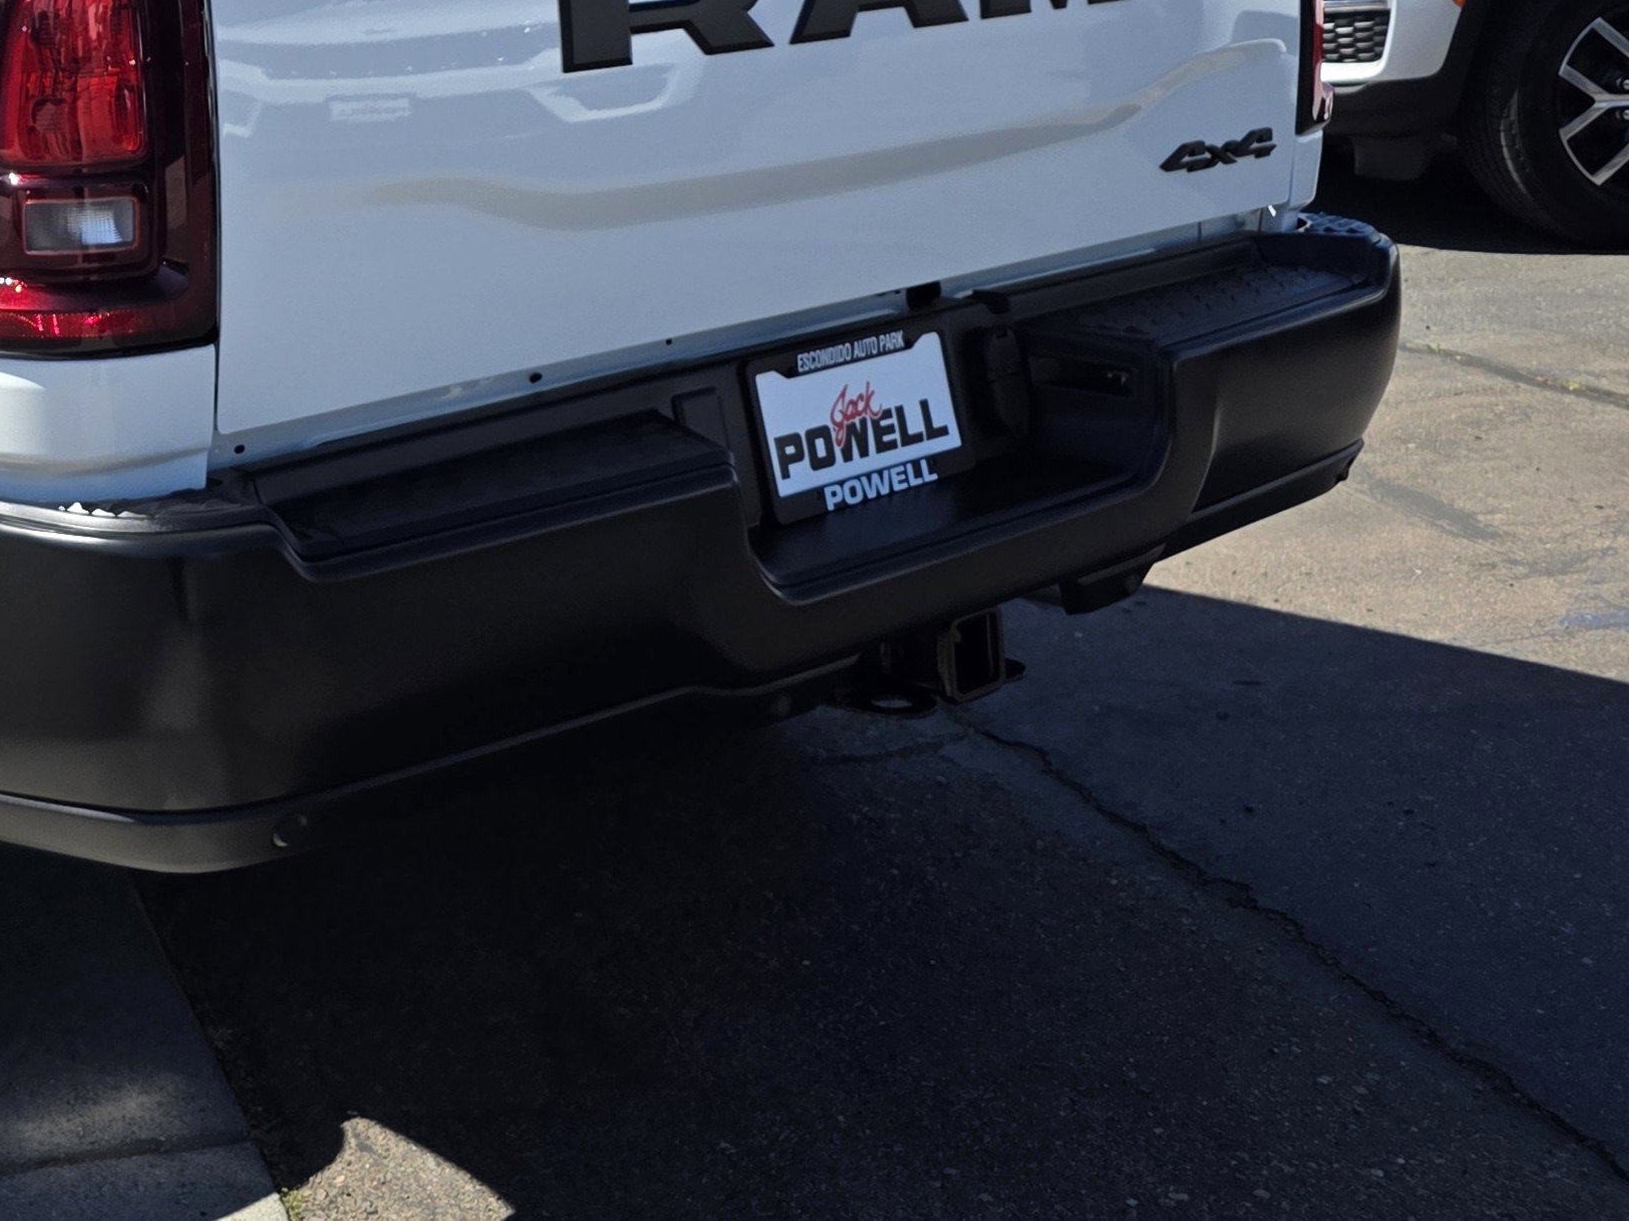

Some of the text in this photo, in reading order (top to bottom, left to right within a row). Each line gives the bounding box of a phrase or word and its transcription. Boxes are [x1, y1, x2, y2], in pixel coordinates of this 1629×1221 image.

[1159, 126, 1277, 173] 4x4
[797, 329, 905, 373] ESCONDIDO AUTO PARK
[774, 398, 950, 480] POWELL
[830, 381, 882, 447] Jack
[824, 458, 938, 511] POWELL
